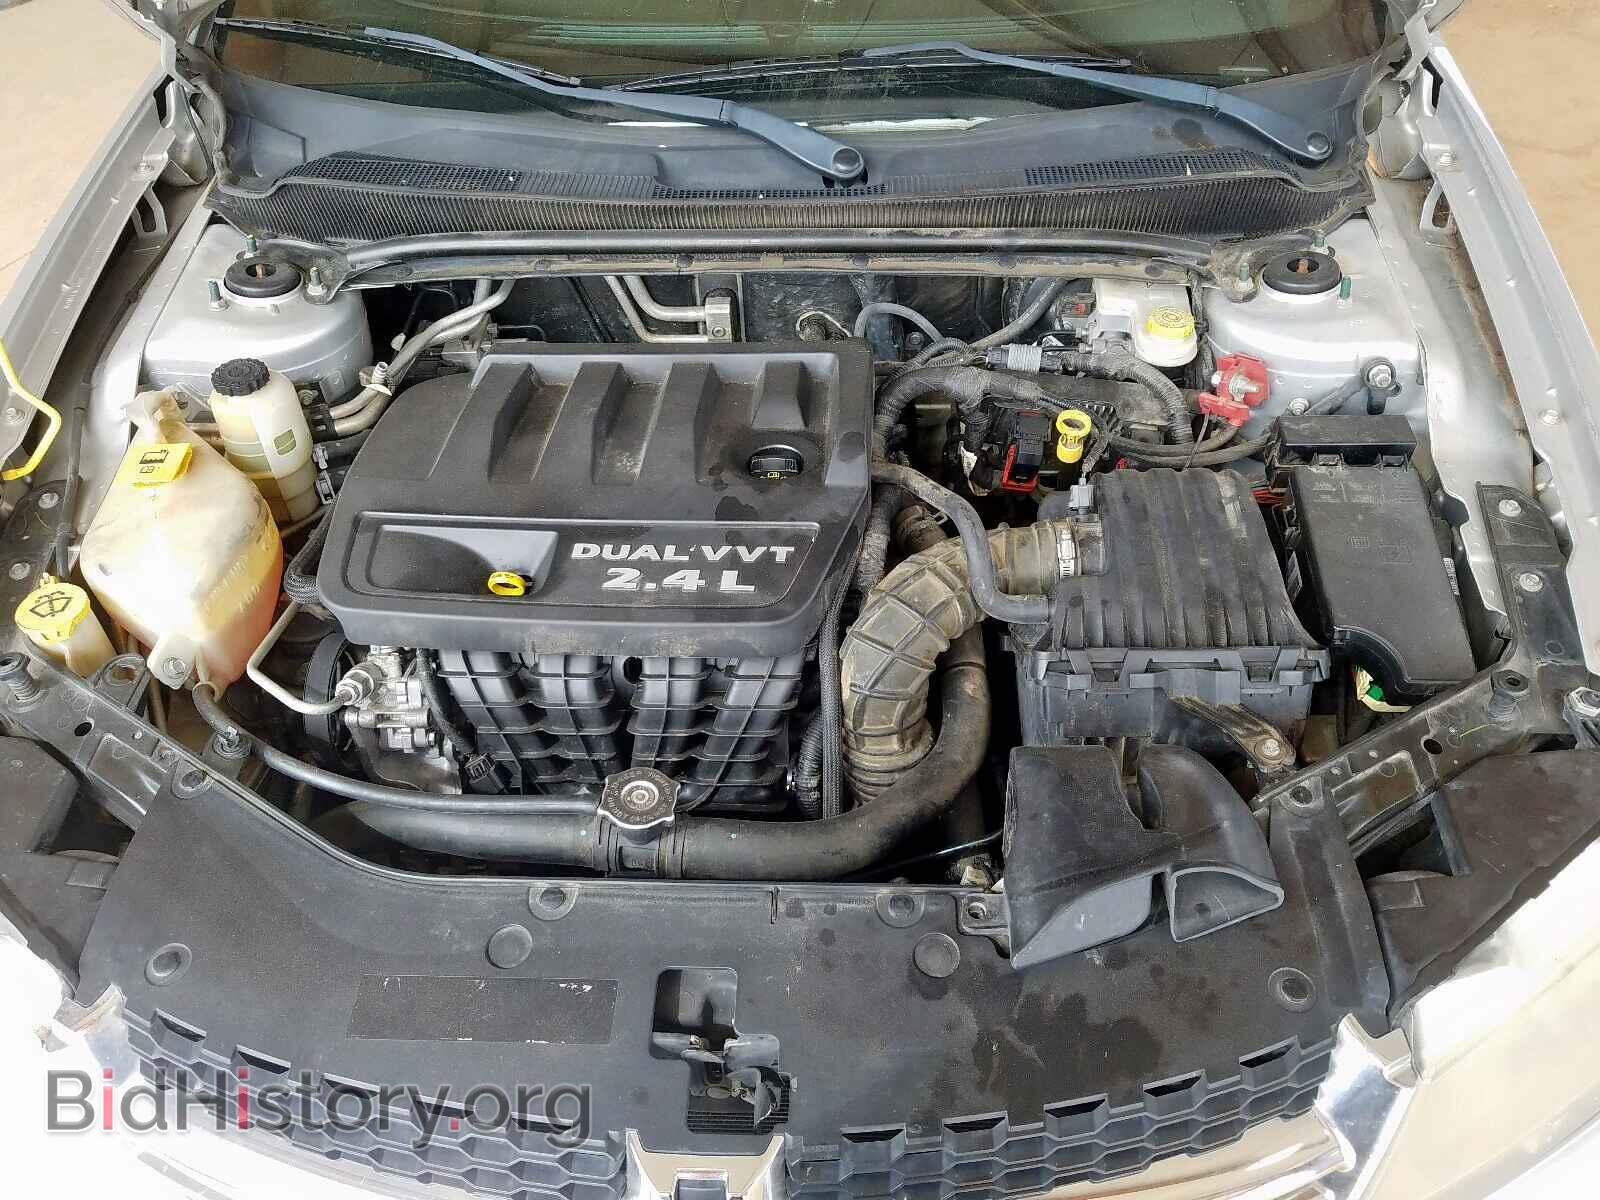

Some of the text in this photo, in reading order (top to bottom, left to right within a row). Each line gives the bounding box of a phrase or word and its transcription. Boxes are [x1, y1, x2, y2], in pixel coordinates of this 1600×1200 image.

[571, 543, 795, 563] DUAL VVT
[602, 567, 756, 592] 2.4 L
